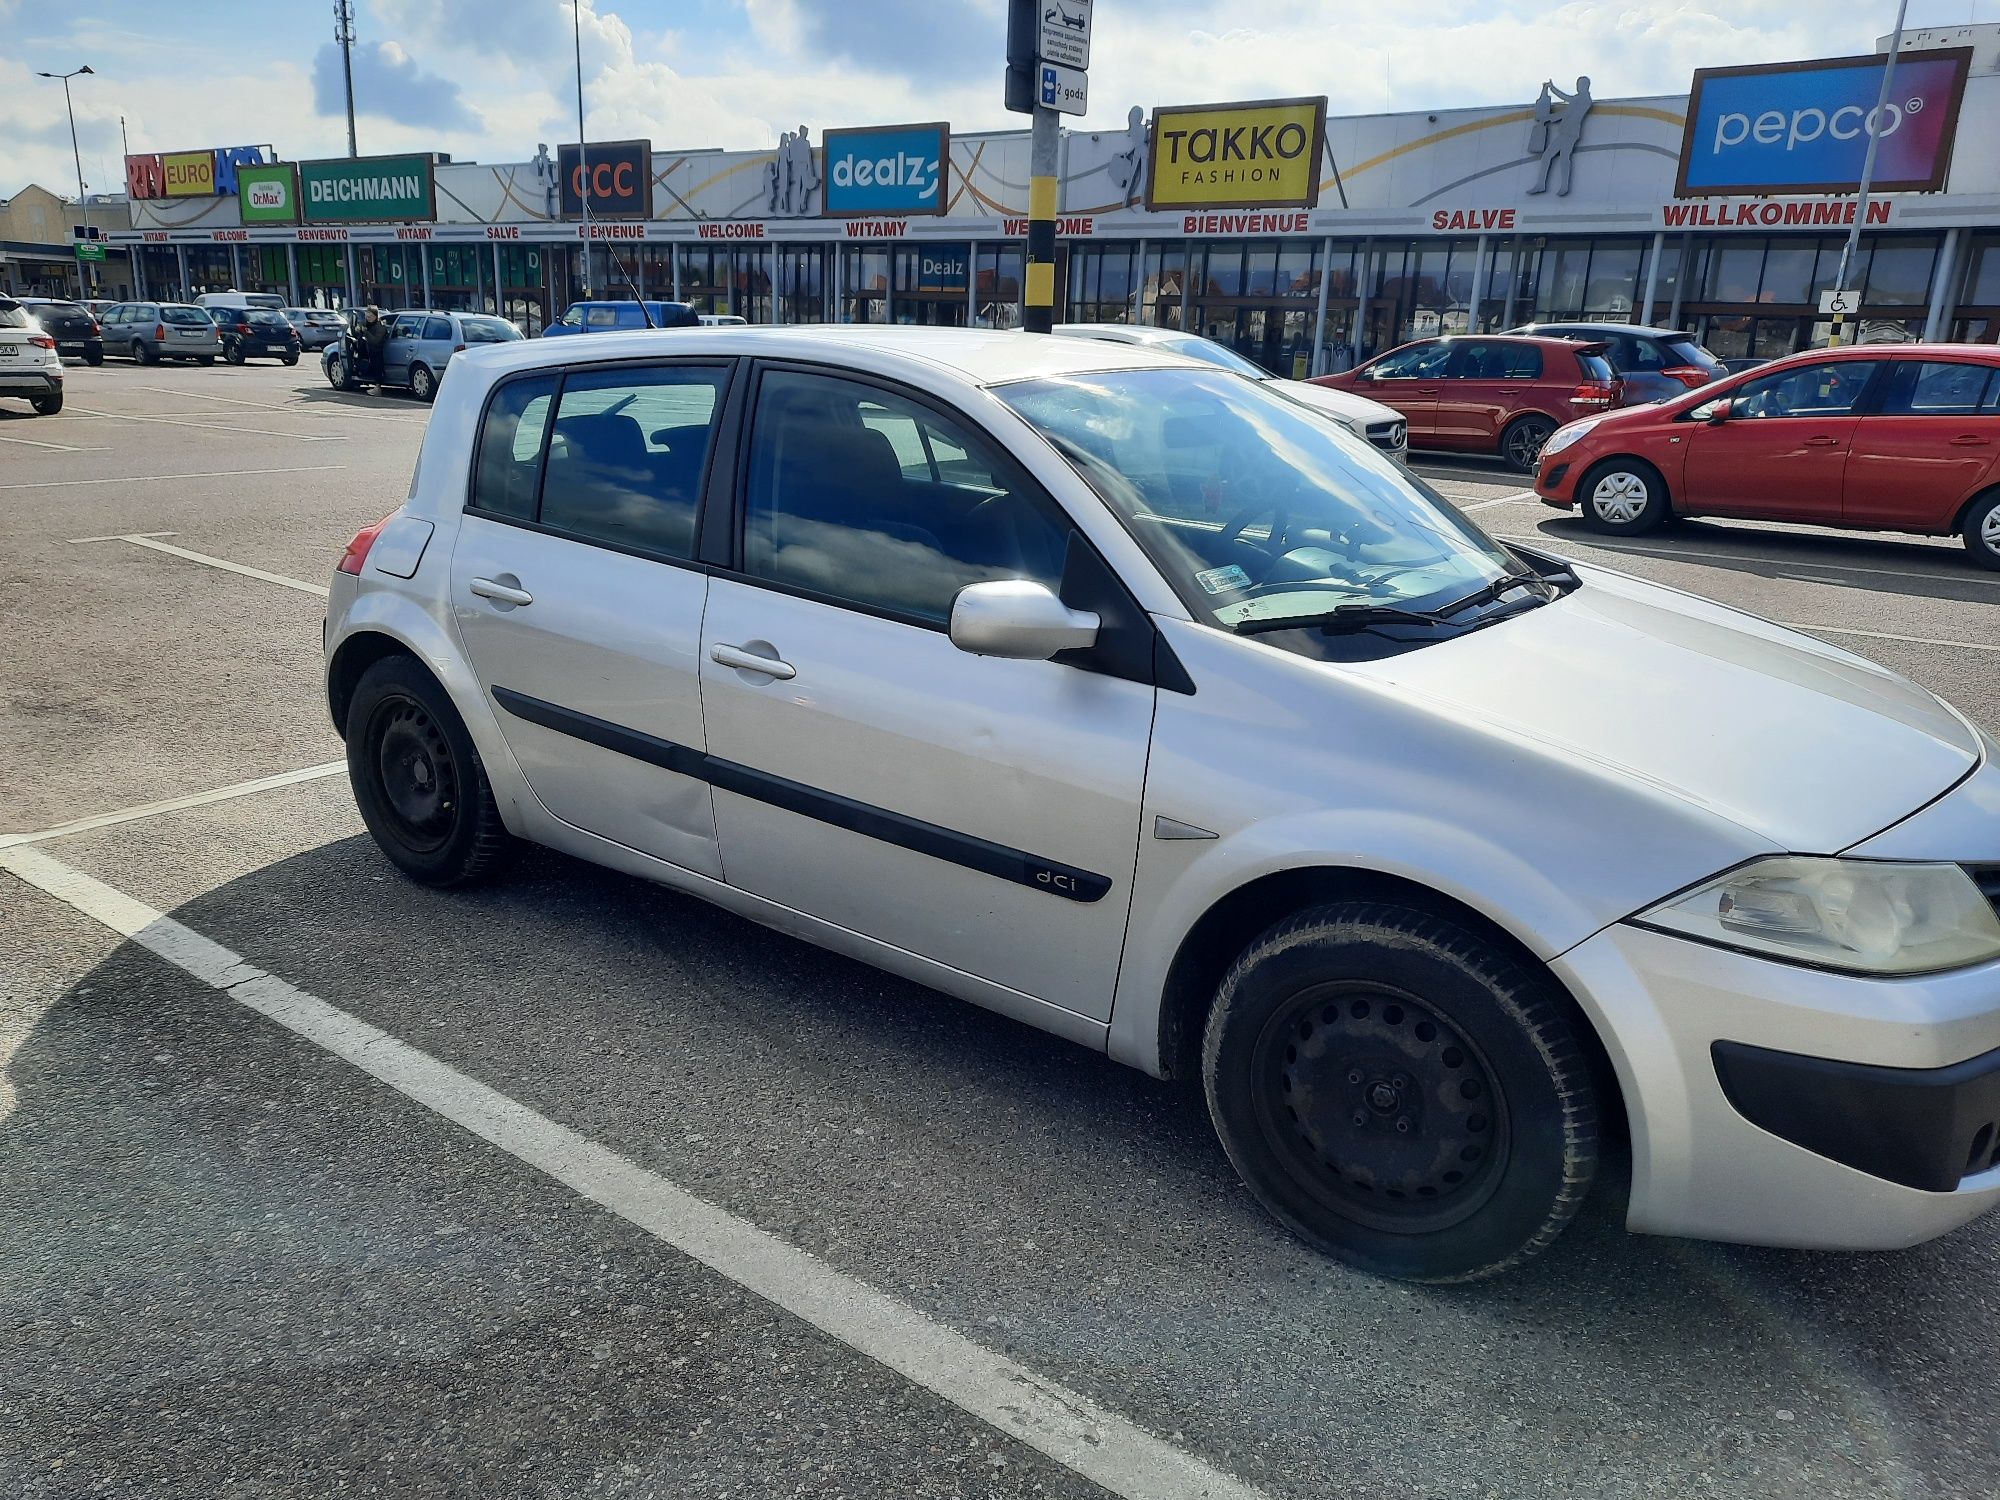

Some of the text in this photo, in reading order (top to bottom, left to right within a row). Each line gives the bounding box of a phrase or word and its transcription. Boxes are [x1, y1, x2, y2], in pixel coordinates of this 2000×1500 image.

[1057, 82, 1062, 95] 2
[1713, 103, 1902, 154] pepco
[167, 163, 210, 185] EURO
[832, 152, 925, 187] dealz
[1181, 168, 1280, 184] FASHION
[572, 161, 634, 198] CCC
[310, 175, 420, 202] DEICHMANN
[1433, 209, 1516, 230] SALVE
[1663, 201, 1891, 226] WILLKOMMEN
[698, 224, 764, 239] WELCOME
[846, 221, 907, 237] WITAMY
[1003, 218, 1093, 235] WEOME
[1183, 213, 1309, 234] BIENVENUE
[143, 231, 168, 242] WITAMY
[212, 230, 248, 241] WELCOME
[298, 229, 348, 240] BENVENUTO
[396, 228, 432, 240] WITAMY
[487, 226, 519, 239] SALVE
[923, 258, 964, 276] Dealz
